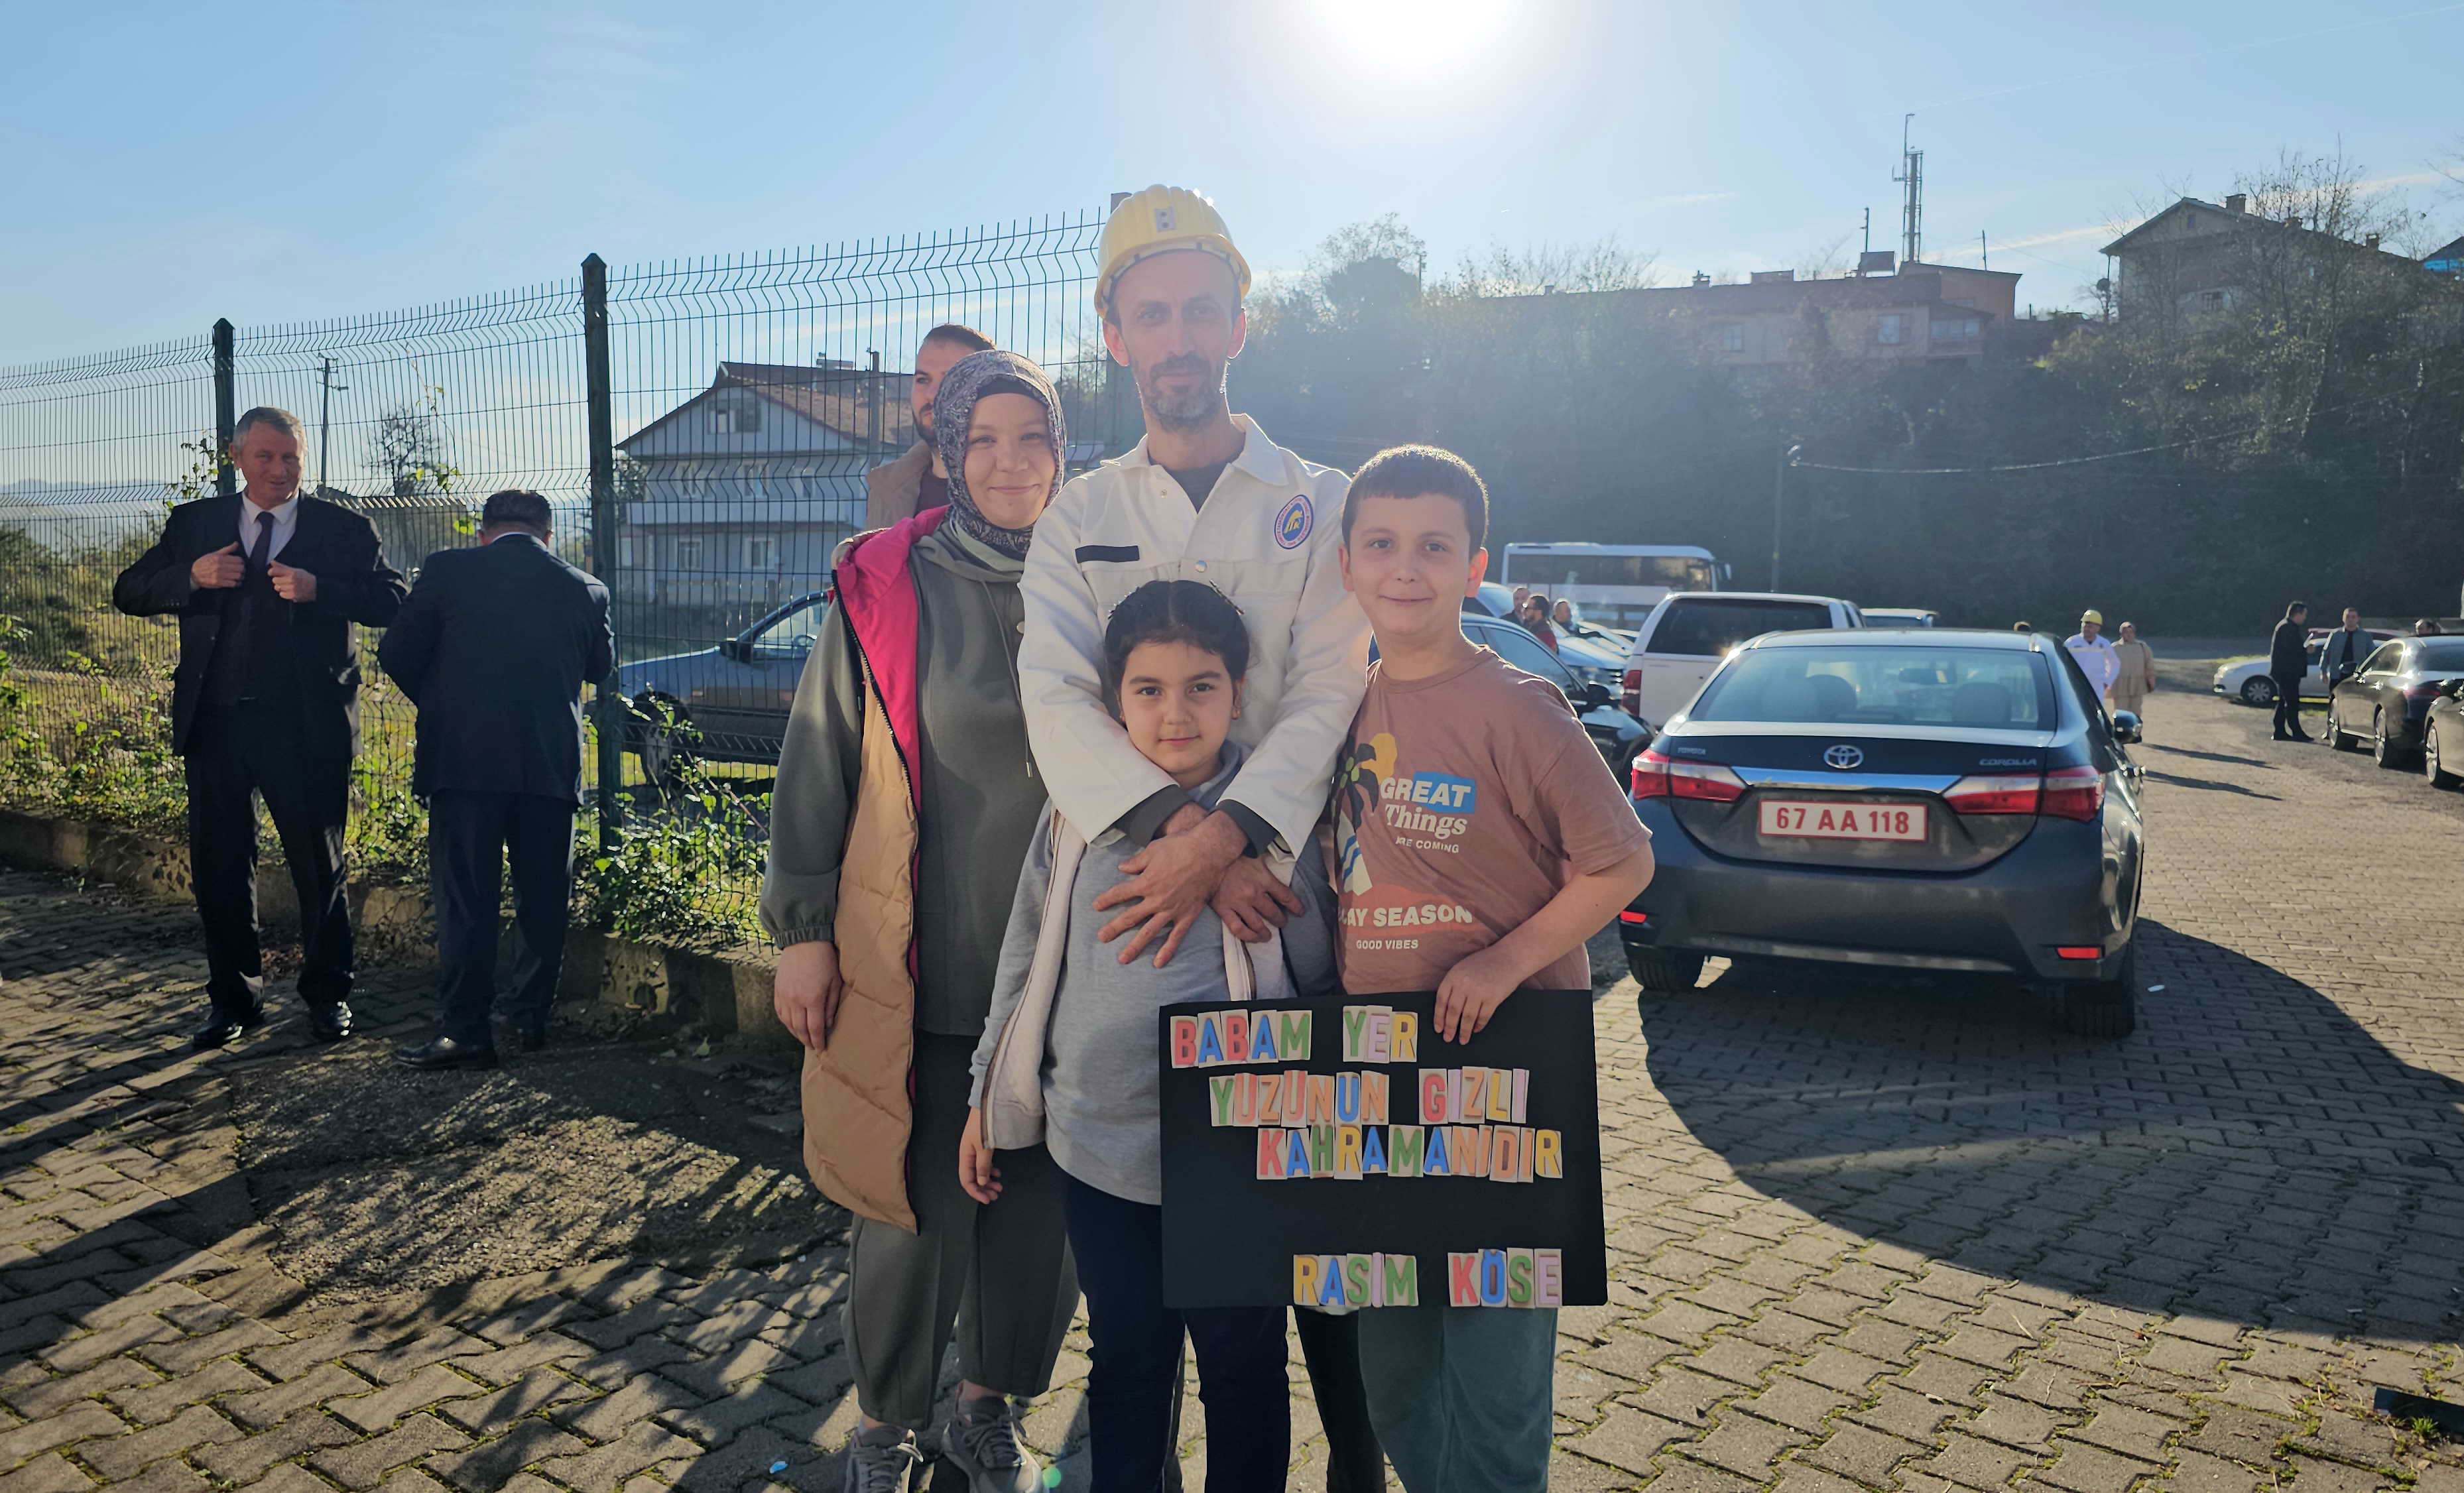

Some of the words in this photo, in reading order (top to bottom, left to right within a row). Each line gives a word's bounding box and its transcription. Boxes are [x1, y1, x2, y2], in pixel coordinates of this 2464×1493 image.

[1380, 777, 1471, 807] GREAT
[1385, 804, 1467, 839] Things
[1776, 807, 1806, 829] 67
[1817, 809, 1858, 831] AA
[1869, 811, 1909, 834] 118
[1416, 840, 1459, 853] COMING
[1373, 904, 1473, 927] SEASON
[1356, 940, 1382, 949] GOOD
[1385, 939, 1419, 949] VIBES
[1174, 1014, 1310, 1065] BABAM
[1344, 1010, 1416, 1059] YER
[1211, 1071, 1386, 1125] YUZUNUN
[1423, 1069, 1526, 1122] GIZLI
[1260, 1125, 1562, 1178] KAHRAMANIDIR
[1294, 1252, 1415, 1307] RASIM
